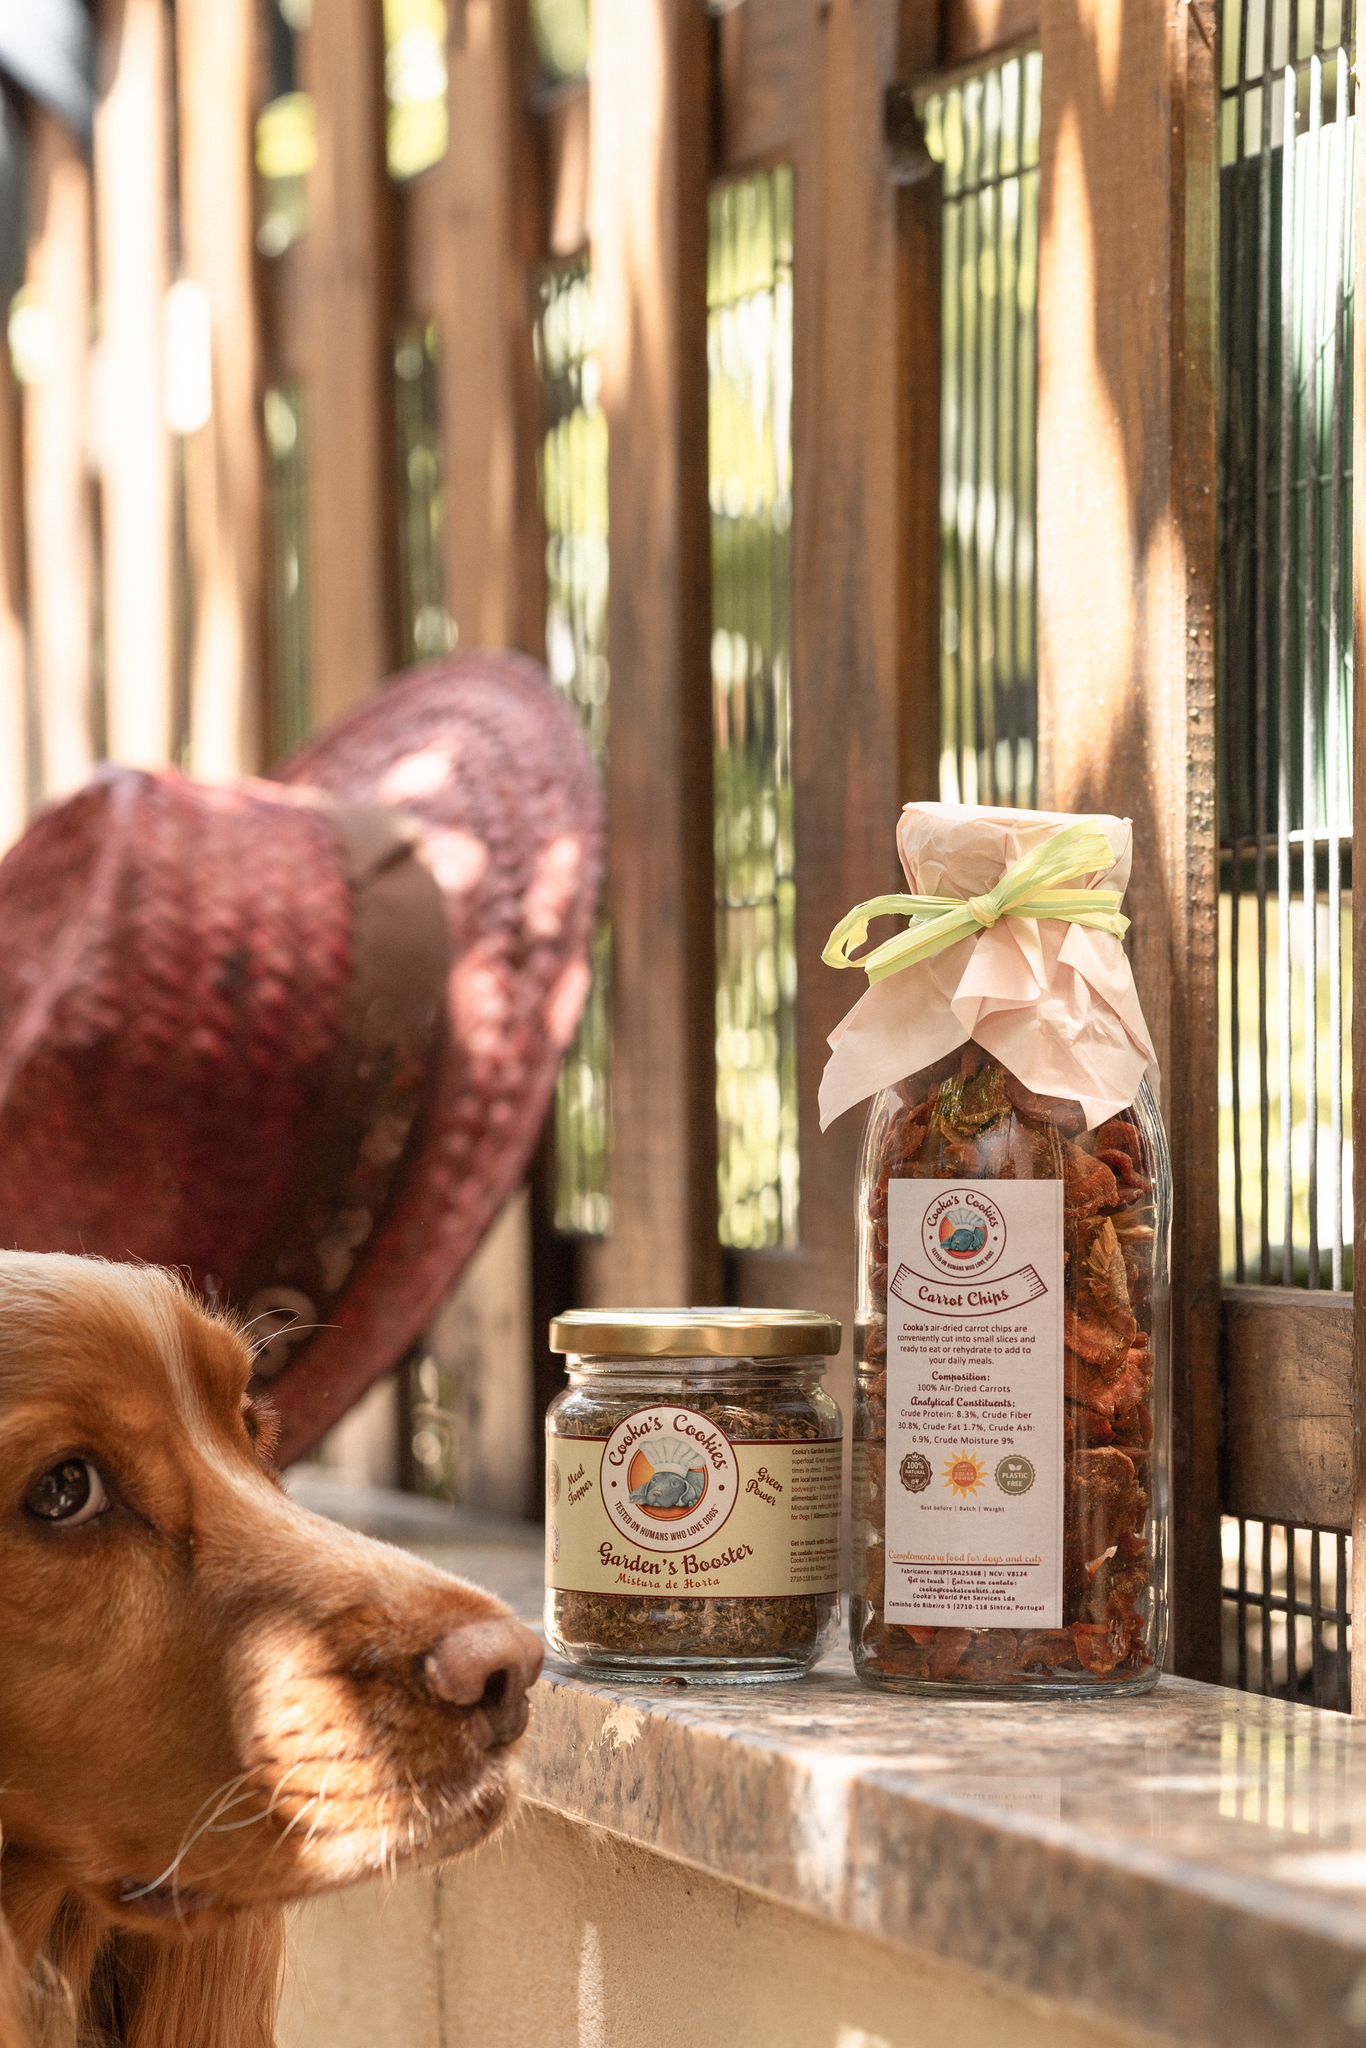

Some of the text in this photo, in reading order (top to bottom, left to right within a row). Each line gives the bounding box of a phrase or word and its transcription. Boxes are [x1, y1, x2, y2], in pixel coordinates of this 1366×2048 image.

[927, 1194, 999, 1228] Cooka's Cookies
[947, 1262, 964, 1271] HUMANS
[965, 1264, 975, 1272] WHO
[975, 1260, 986, 1270] LOVE
[918, 1286, 1009, 1307] Carrot Chips
[903, 1324, 929, 1332] Cooka's
[931, 1324, 963, 1333] air-dried
[965, 1325, 989, 1333] carrot
[991, 1325, 1012, 1334] chips
[898, 1335, 940, 1344] conveniently
[1020, 1336, 1036, 1344] and
[901, 1346, 919, 1355] ready
[953, 1346, 992, 1355] rehydrate
[1005, 1346, 1021, 1354] add
[930, 1357, 995, 1366] your daily meals.
[932, 1371, 991, 1383] Composition:
[918, 1384, 938, 1392] 100%
[980, 1385, 1012, 1393] Carrots
[911, 1397, 1016, 1408] Analytical Constituents:
[901, 1409, 1033, 1420] Crude Protein: 8.3%, Crude Fiber
[898, 1422, 1036, 1432] 30.8%, Crude Fat 1.7%, Crude Ash:
[609, 1414, 727, 1471] Cooka's Cookies
[912, 1436, 1015, 1445] 6.9%, Crude Moisture 9%
[907, 1461, 925, 1470] 100%
[568, 1464, 586, 1491] Meal
[756, 1467, 783, 1493] Green
[1002, 1472, 1028, 1480] PLASTIC
[568, 1480, 593, 1506] Topper
[745, 1479, 777, 1507] Power
[614, 1500, 633, 1525] TESTED
[631, 1521, 641, 1532] ON
[640, 1528, 669, 1542] HUMANS
[670, 1532, 687, 1542] WHO
[687, 1521, 706, 1538] LOVE
[597, 1542, 679, 1575] Garden's
[681, 1544, 754, 1575] Booster
[946, 1552, 965, 1563] food
[967, 1552, 981, 1563] for
[983, 1554, 1004, 1564] dogs
[1006, 1555, 1023, 1563] and
[1025, 1555, 1043, 1563] cats
[615, 1573, 721, 1589] Mistura de Horta
[990, 1604, 1013, 1612] Sintra,
